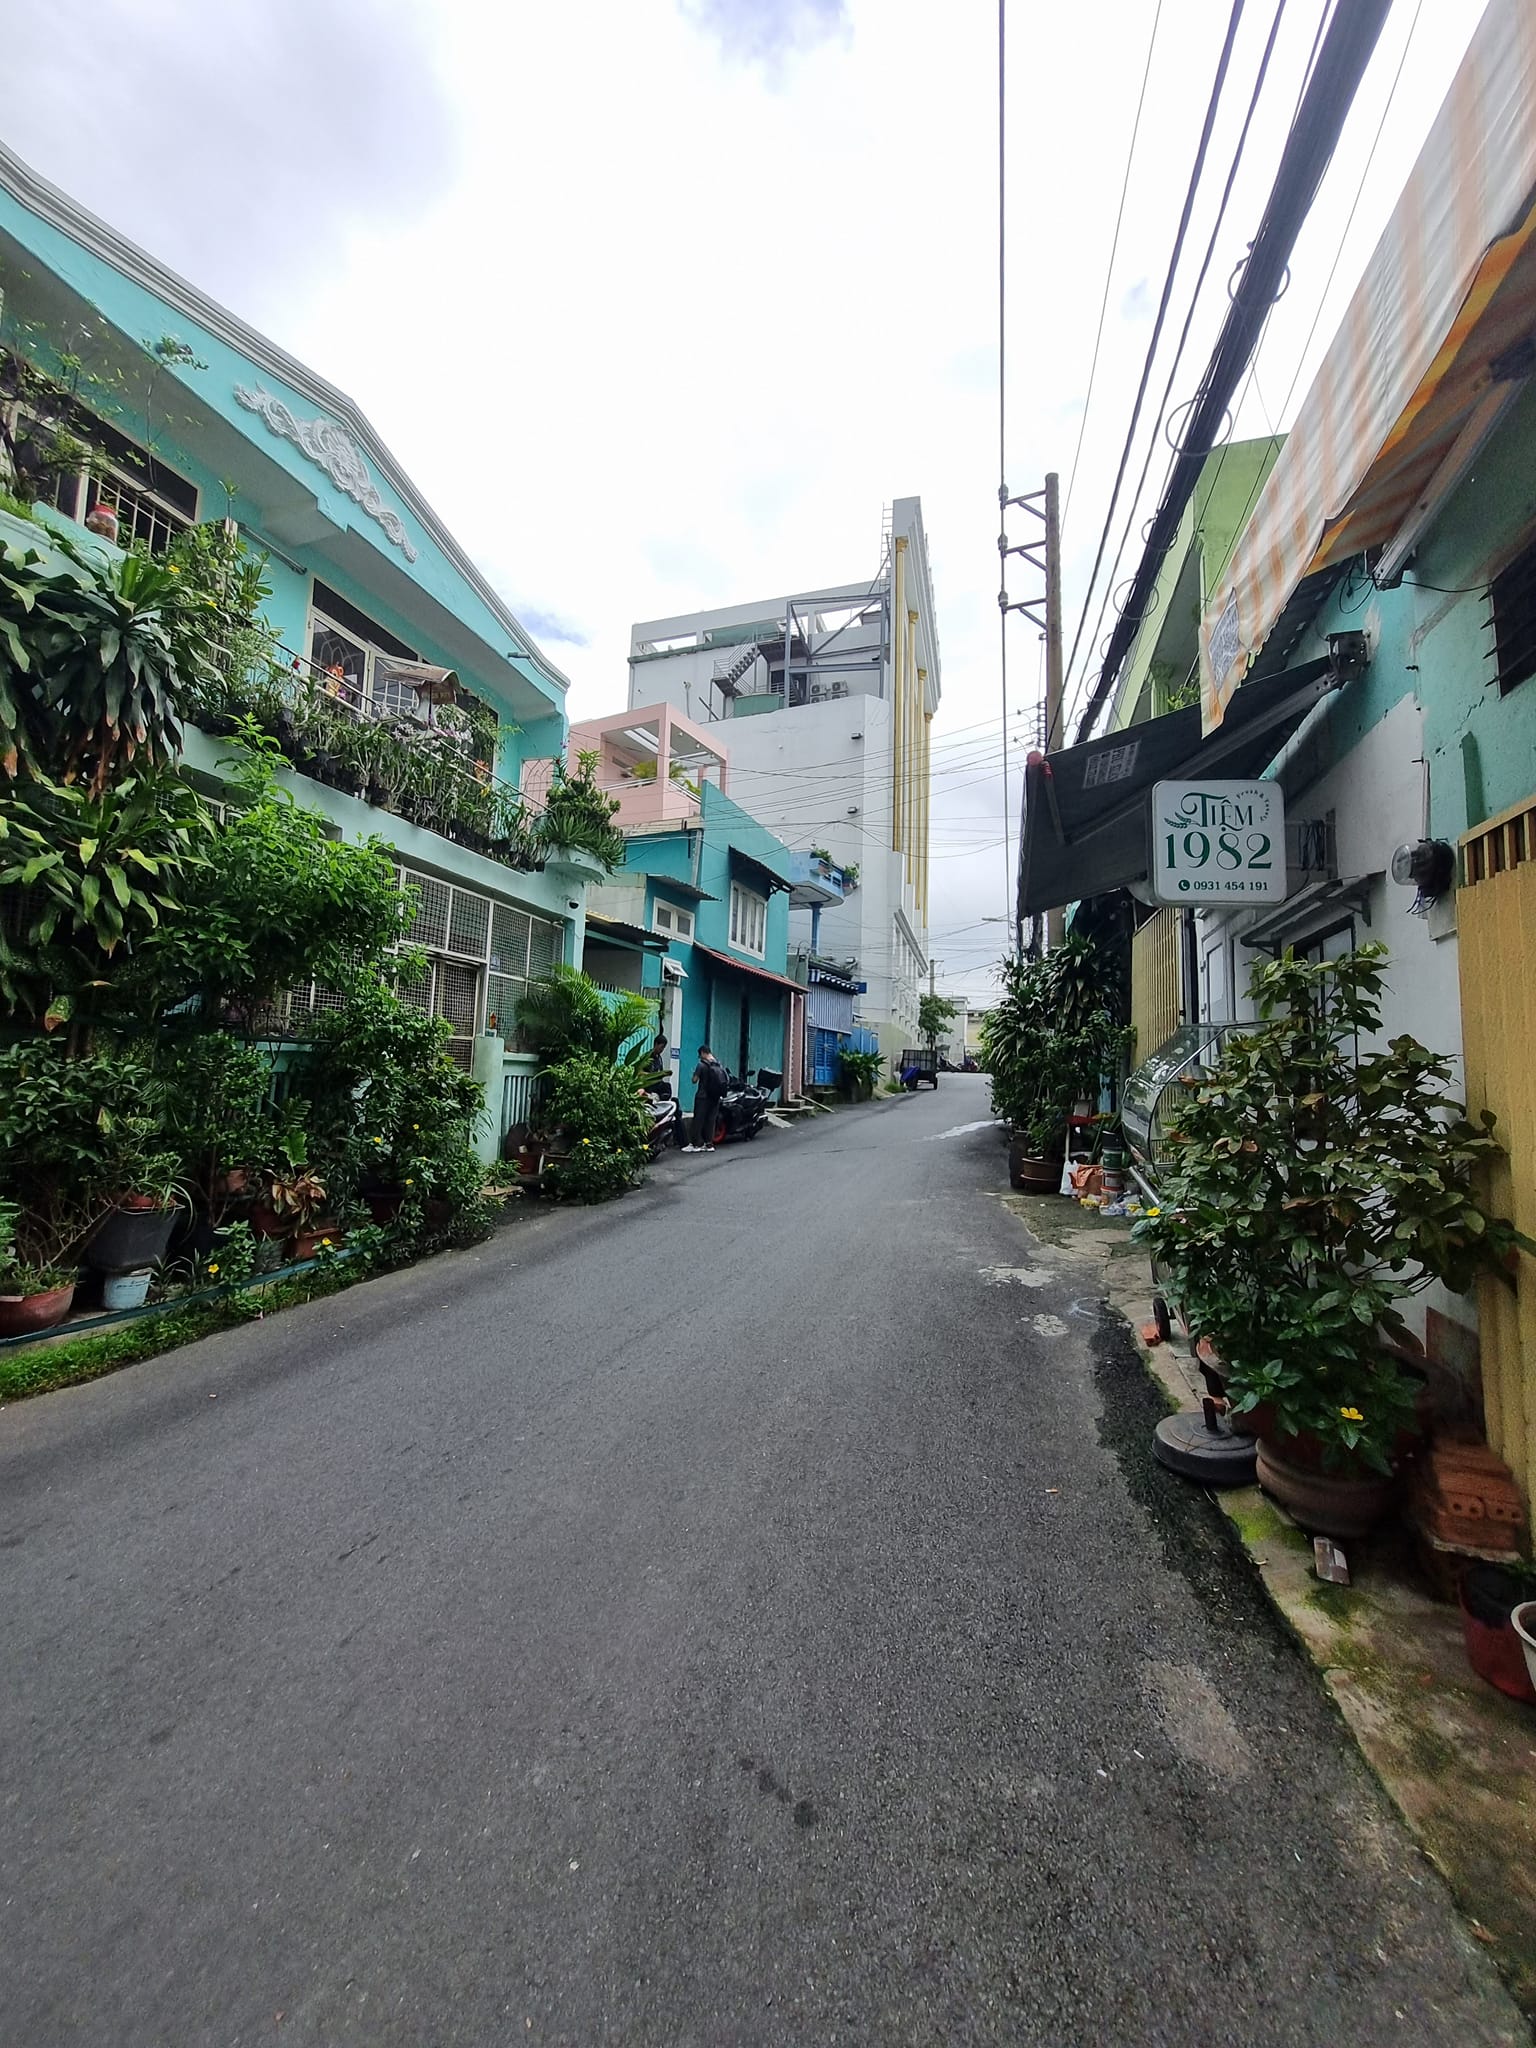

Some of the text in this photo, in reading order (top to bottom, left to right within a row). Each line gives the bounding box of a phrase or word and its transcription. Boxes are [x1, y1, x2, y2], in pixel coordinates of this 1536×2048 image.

[1181, 792, 1253, 832] TIỆM
[1165, 831, 1272, 870] 1982
[1193, 881, 1268, 891] 0931 454 191
